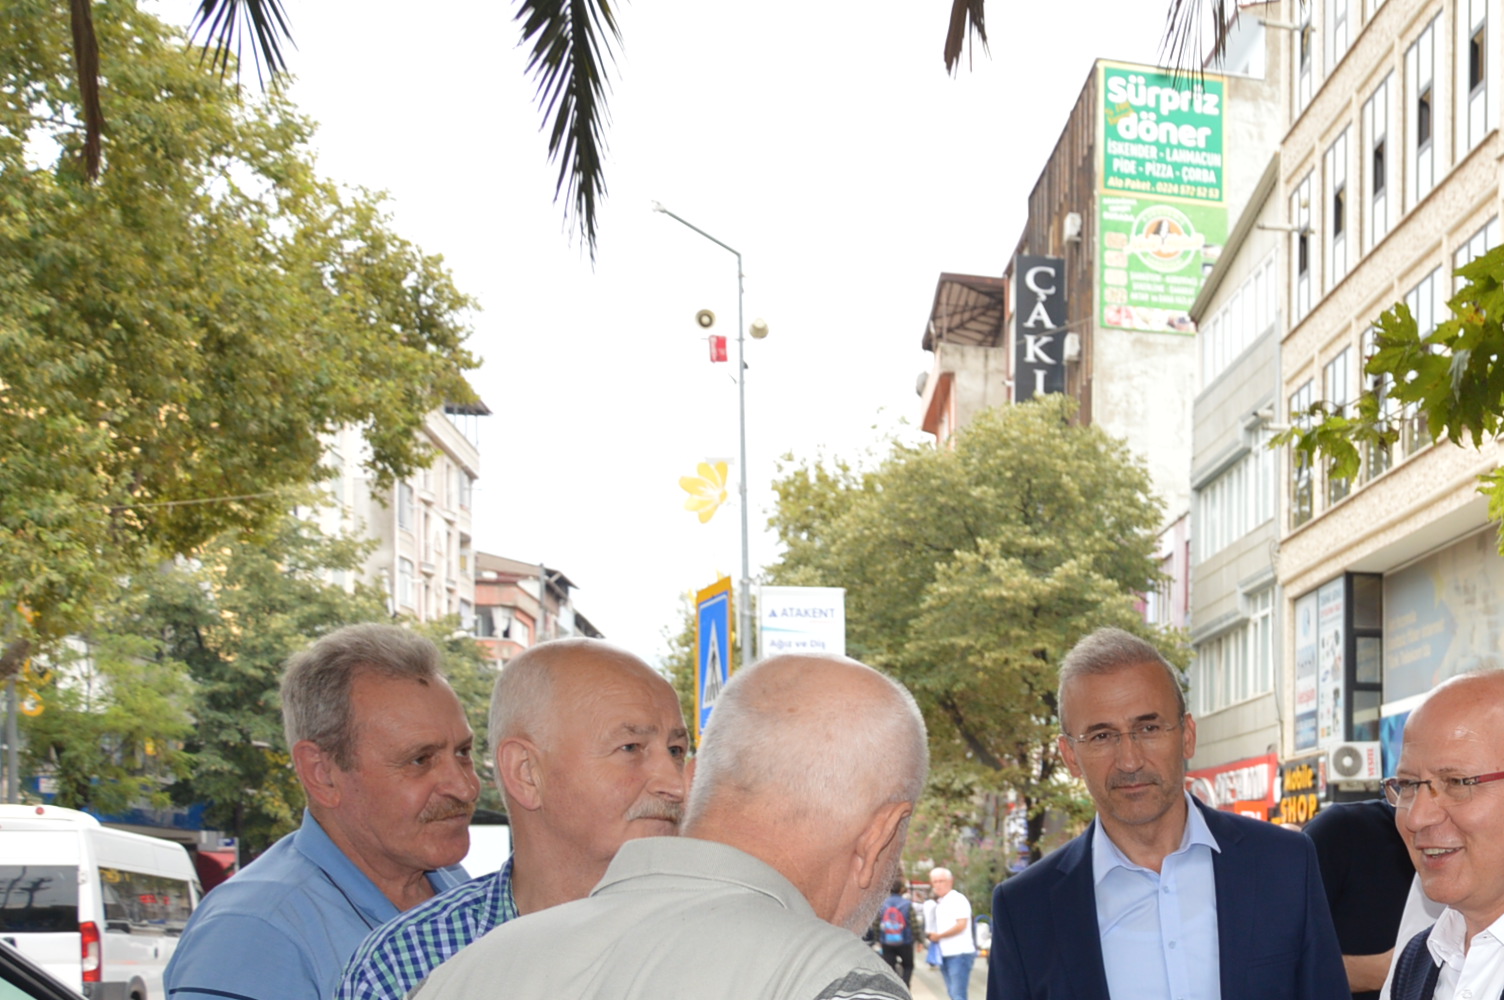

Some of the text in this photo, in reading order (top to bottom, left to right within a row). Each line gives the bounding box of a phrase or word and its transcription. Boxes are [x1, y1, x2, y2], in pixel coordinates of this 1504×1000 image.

[1107, 74, 1219, 116] Sürpriz
[1117, 110, 1212, 148] döner
[1107, 137, 1157, 160] İSKENDER
[1165, 147, 1221, 167] LAHMACUN
[1112, 157, 1137, 174] PİDE
[1145, 160, 1174, 178] PİZZA
[1181, 165, 1216, 184] ÇORBA
[781, 607, 835, 618] ATAKENT
[1284, 764, 1314, 790] Mobile
[1280, 793, 1317, 824] SHOP
